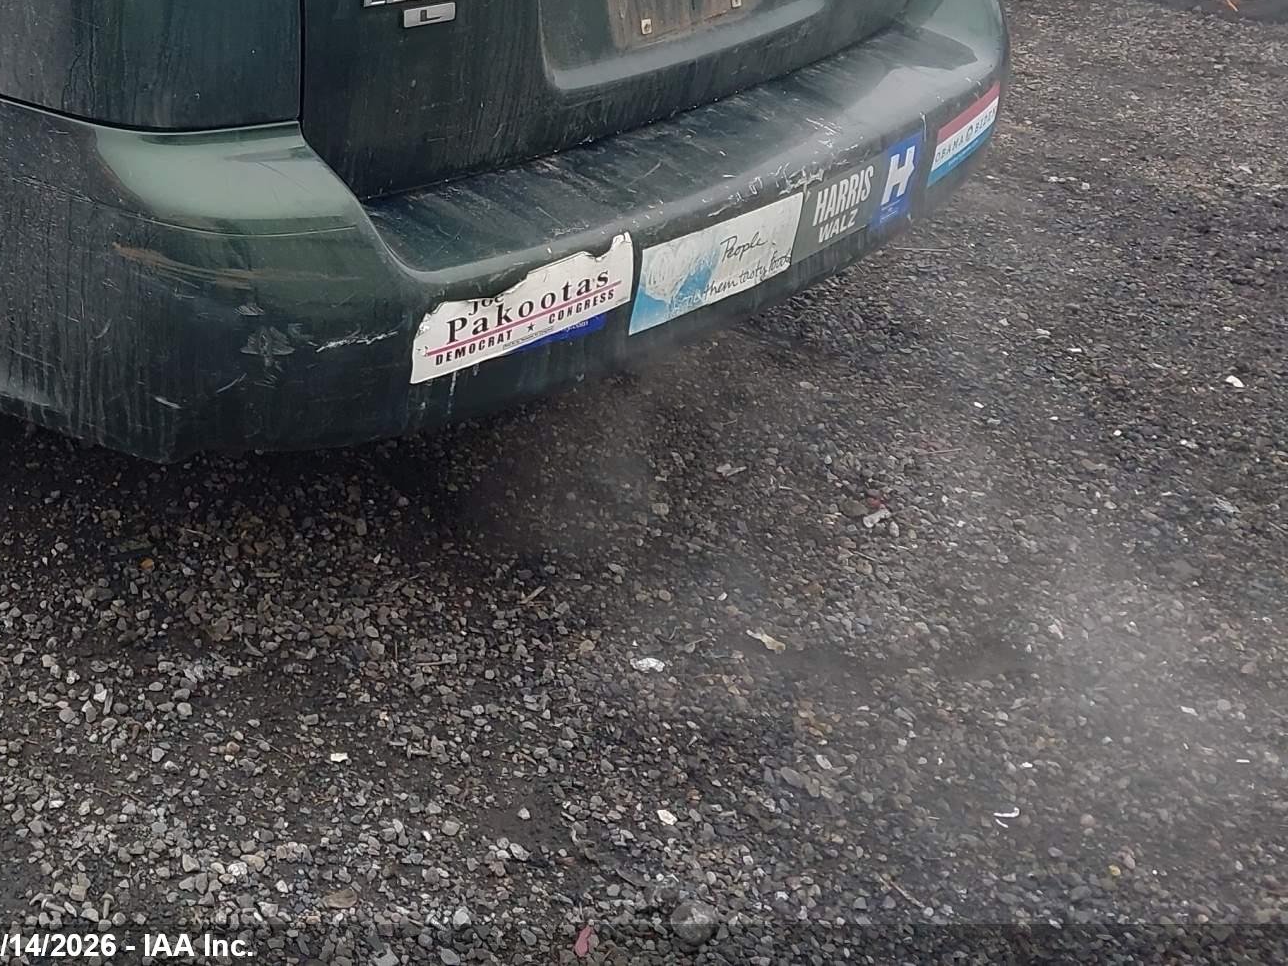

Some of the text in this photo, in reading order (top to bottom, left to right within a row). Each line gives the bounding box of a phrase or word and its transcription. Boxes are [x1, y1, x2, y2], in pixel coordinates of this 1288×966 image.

[419, 9, 442, 22] L
[813, 165, 874, 227] HARRIS
[819, 208, 859, 243] WALZ
[702, 279, 738, 299] them
[739, 260, 767, 281] tasty
[435, 329, 513, 366] DEMOCRAT
[548, 288, 615, 325] CONGRESS
[446, 269, 610, 345] Pakootas
